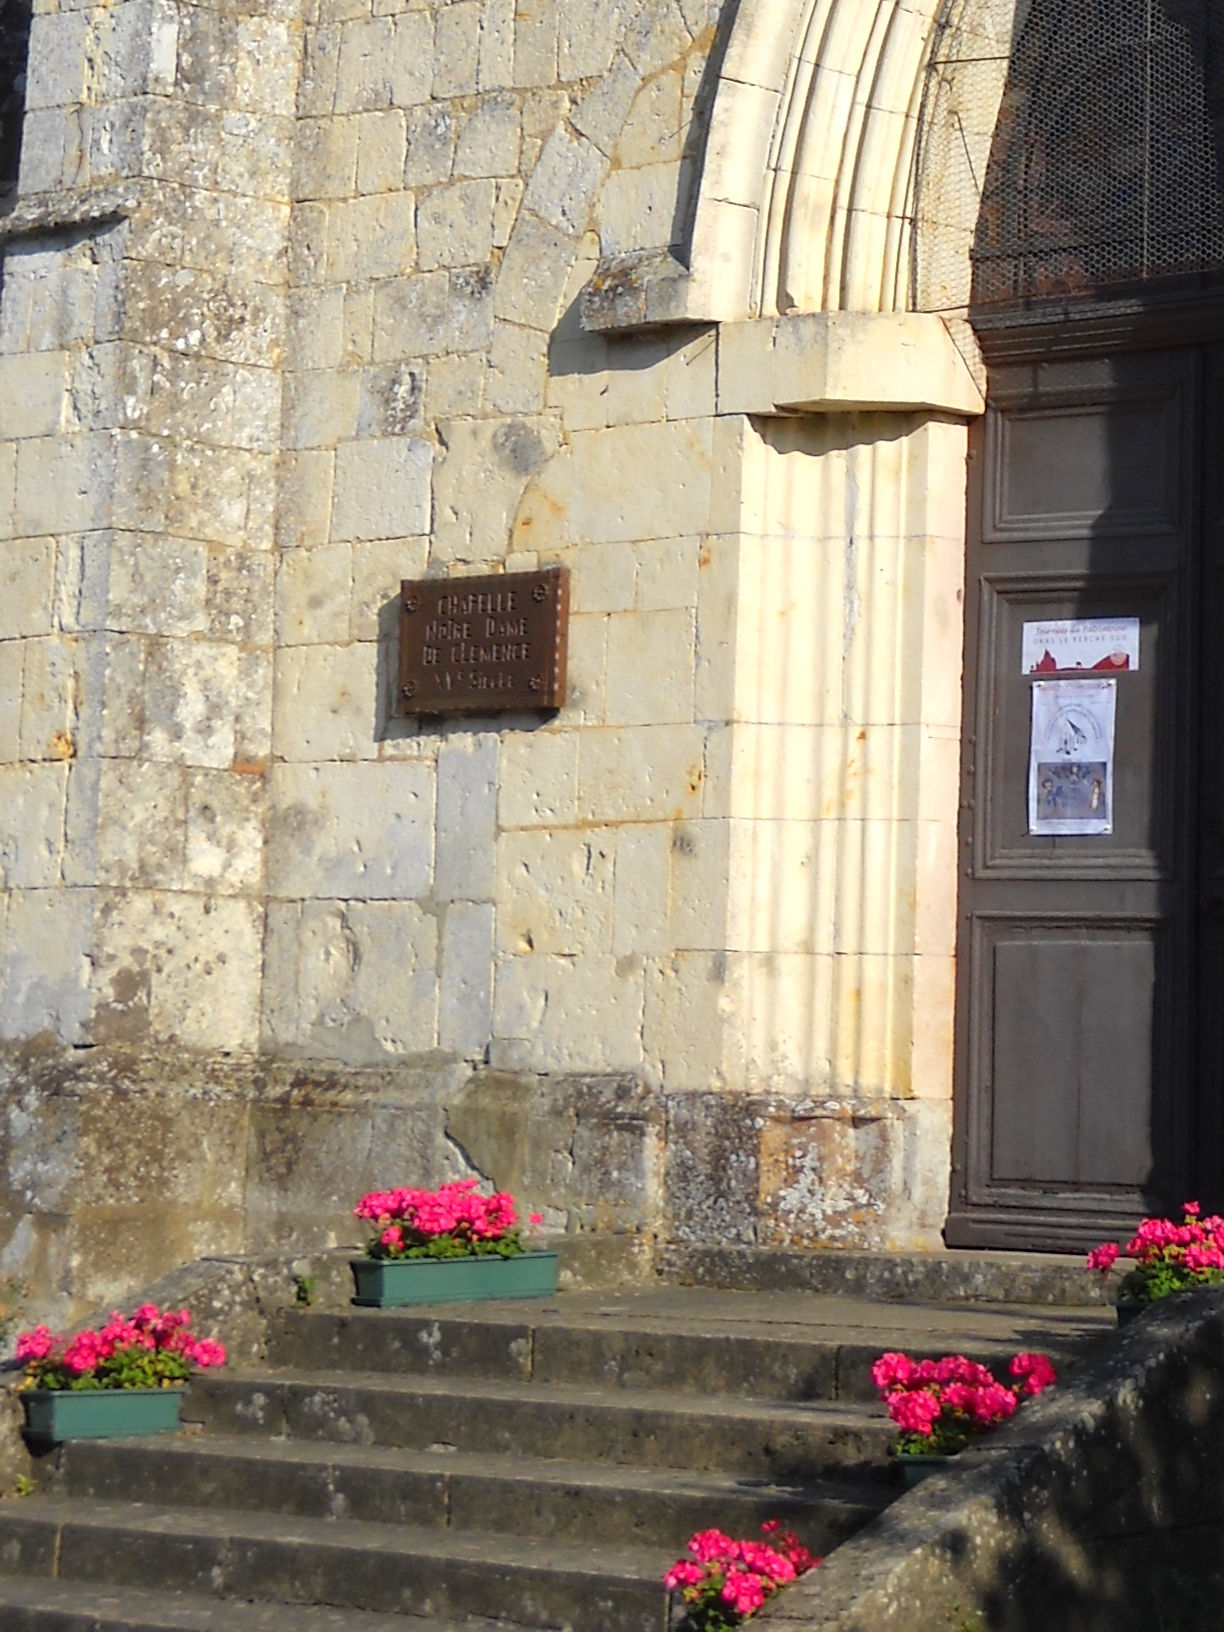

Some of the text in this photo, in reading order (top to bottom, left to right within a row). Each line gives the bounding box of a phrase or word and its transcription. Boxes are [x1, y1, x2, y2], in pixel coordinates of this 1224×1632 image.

[438, 591, 517, 615] CHAPELLE
[425, 615, 528, 641] NOTRE DAME
[1073, 635, 1105, 643] PERCHE
[1110, 634, 1126, 642] SUD
[422, 644, 441, 666] DE
